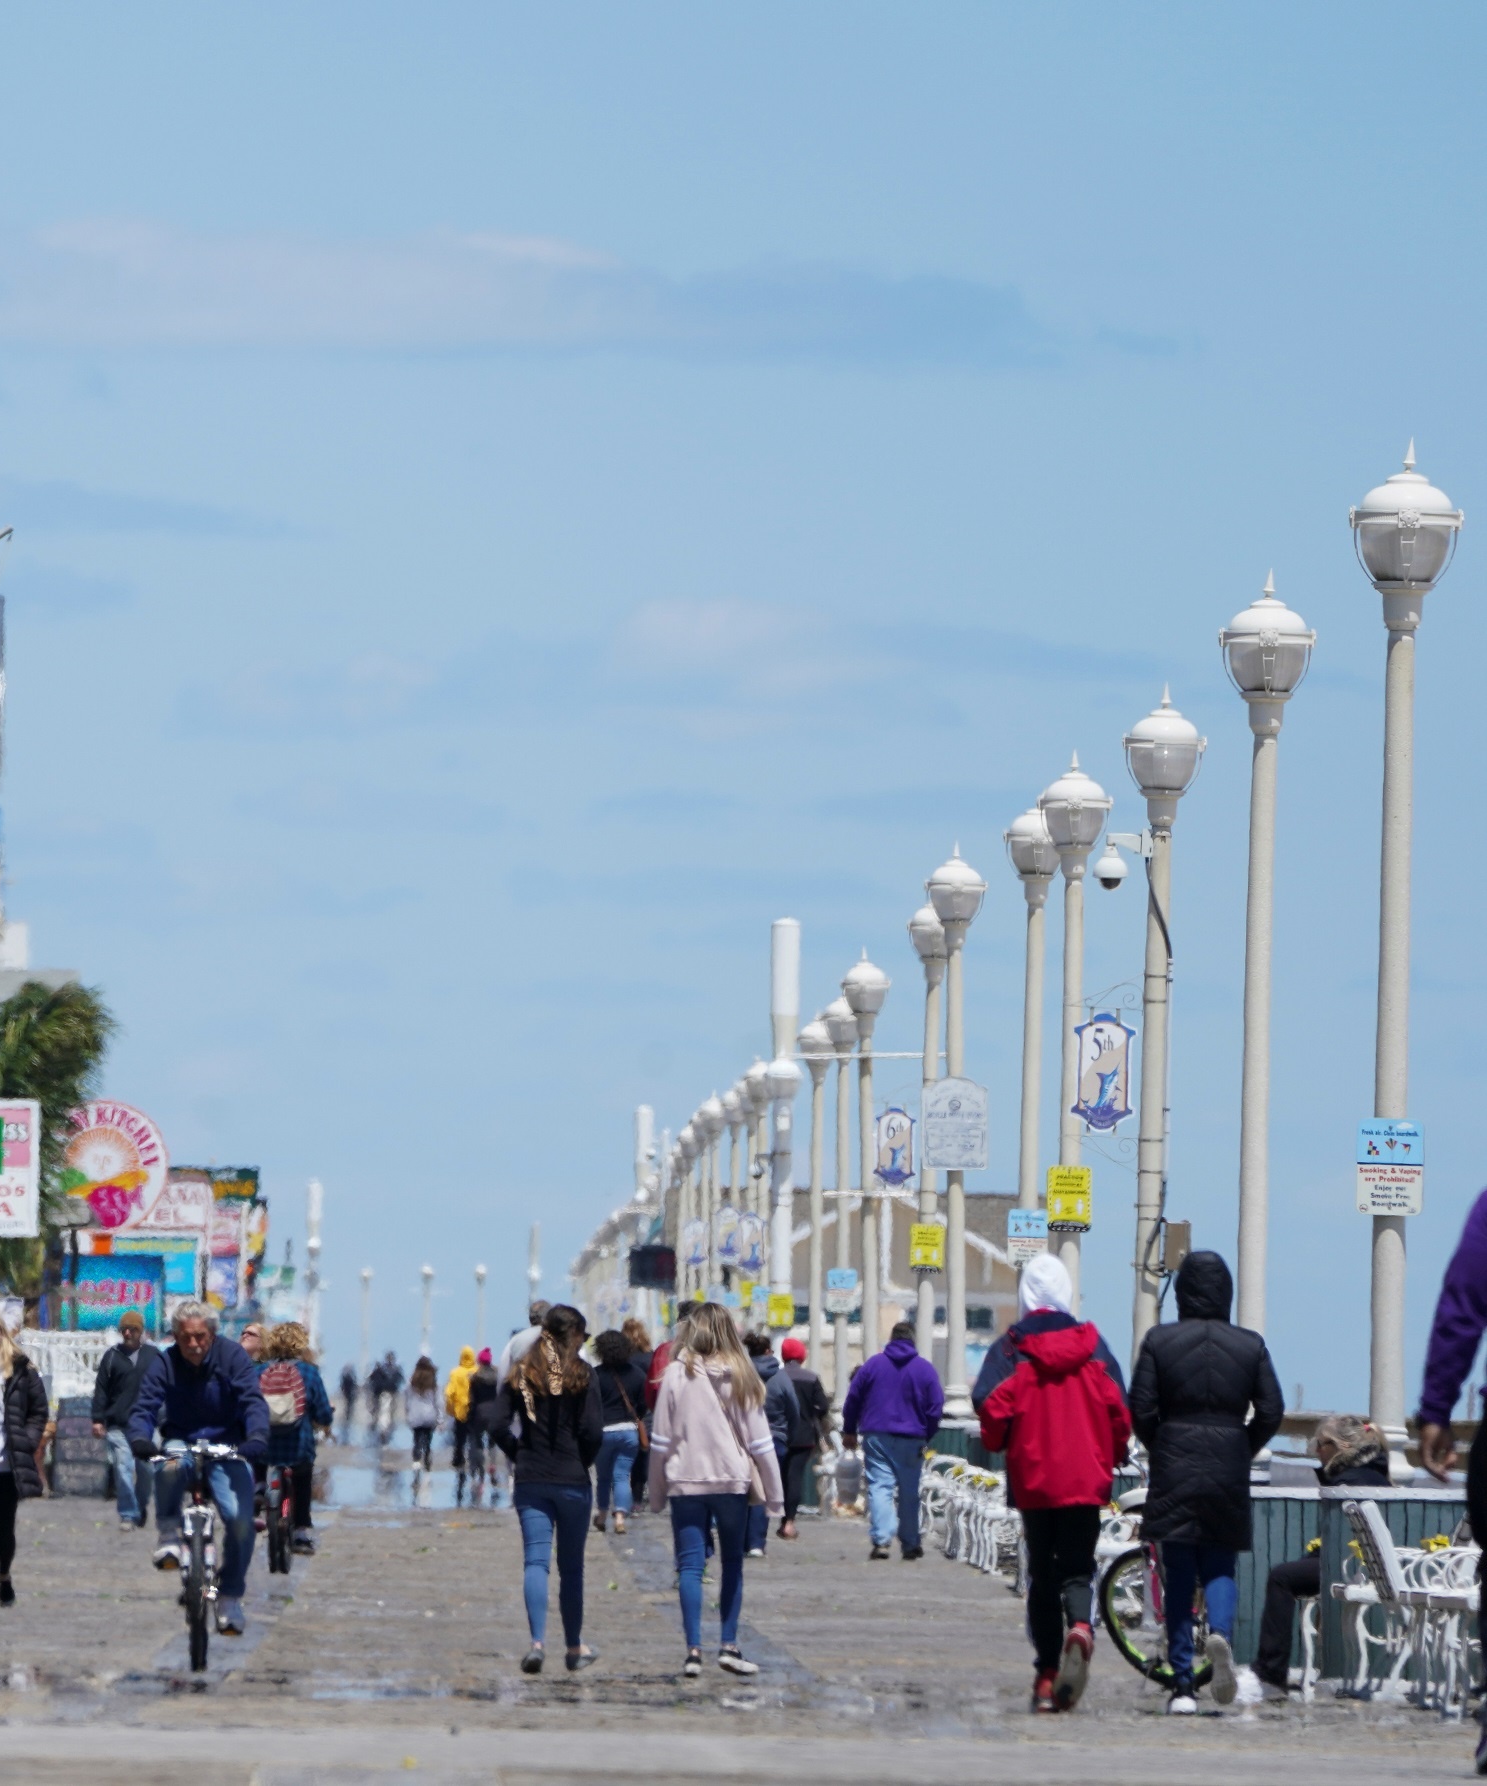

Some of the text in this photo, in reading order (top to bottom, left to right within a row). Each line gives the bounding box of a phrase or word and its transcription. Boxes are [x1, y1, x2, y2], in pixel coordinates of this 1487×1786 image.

[1090, 1027, 1115, 1062] 5th
[885, 1116, 905, 1140] 6th
[1359, 1167, 1387, 1175] Smoking
